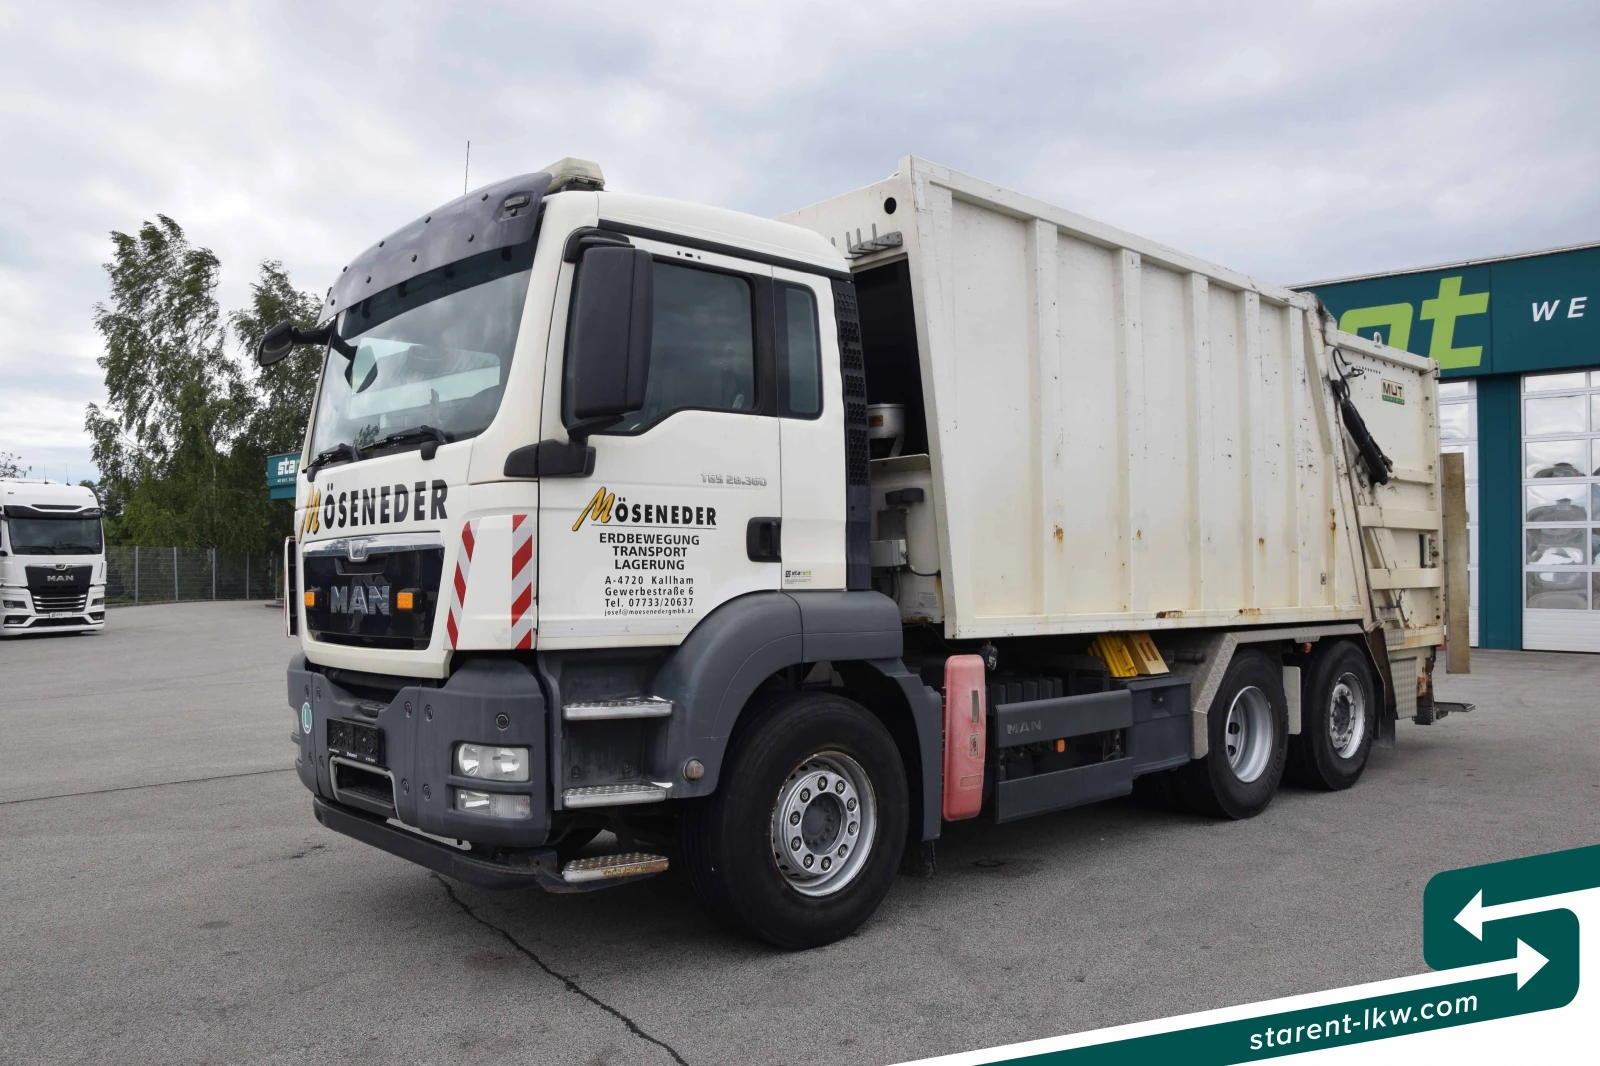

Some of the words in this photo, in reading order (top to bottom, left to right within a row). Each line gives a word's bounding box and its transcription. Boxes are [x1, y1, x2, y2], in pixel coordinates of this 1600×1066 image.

[1532, 296, 1587, 322] WE
[1383, 382, 1402, 397] MUT
[701, 473, 723, 484] TGS
[726, 475, 767, 486] 28.360
[298, 479, 448, 544] MÖSENEDER
[572, 486, 717, 532] MÖSENEDER
[600, 533, 700, 545] ERDBEWEGUNG
[612, 546, 688, 557] TRANSPORT
[615, 559, 685, 570] LAGERUNG
[605, 575, 644, 585] A-4720
[651, 575, 694, 585] Kallham
[605, 586, 685, 596] Gewerbestraße
[688, 586, 694, 596] 6
[330, 585, 390, 615] MAN
[605, 597, 624, 607] Tel.
[628, 597, 694, 608] 07733/20637
[604, 608, 694, 616] josef@moesenedergmbh.at
[1007, 720, 1041, 735] MAN
